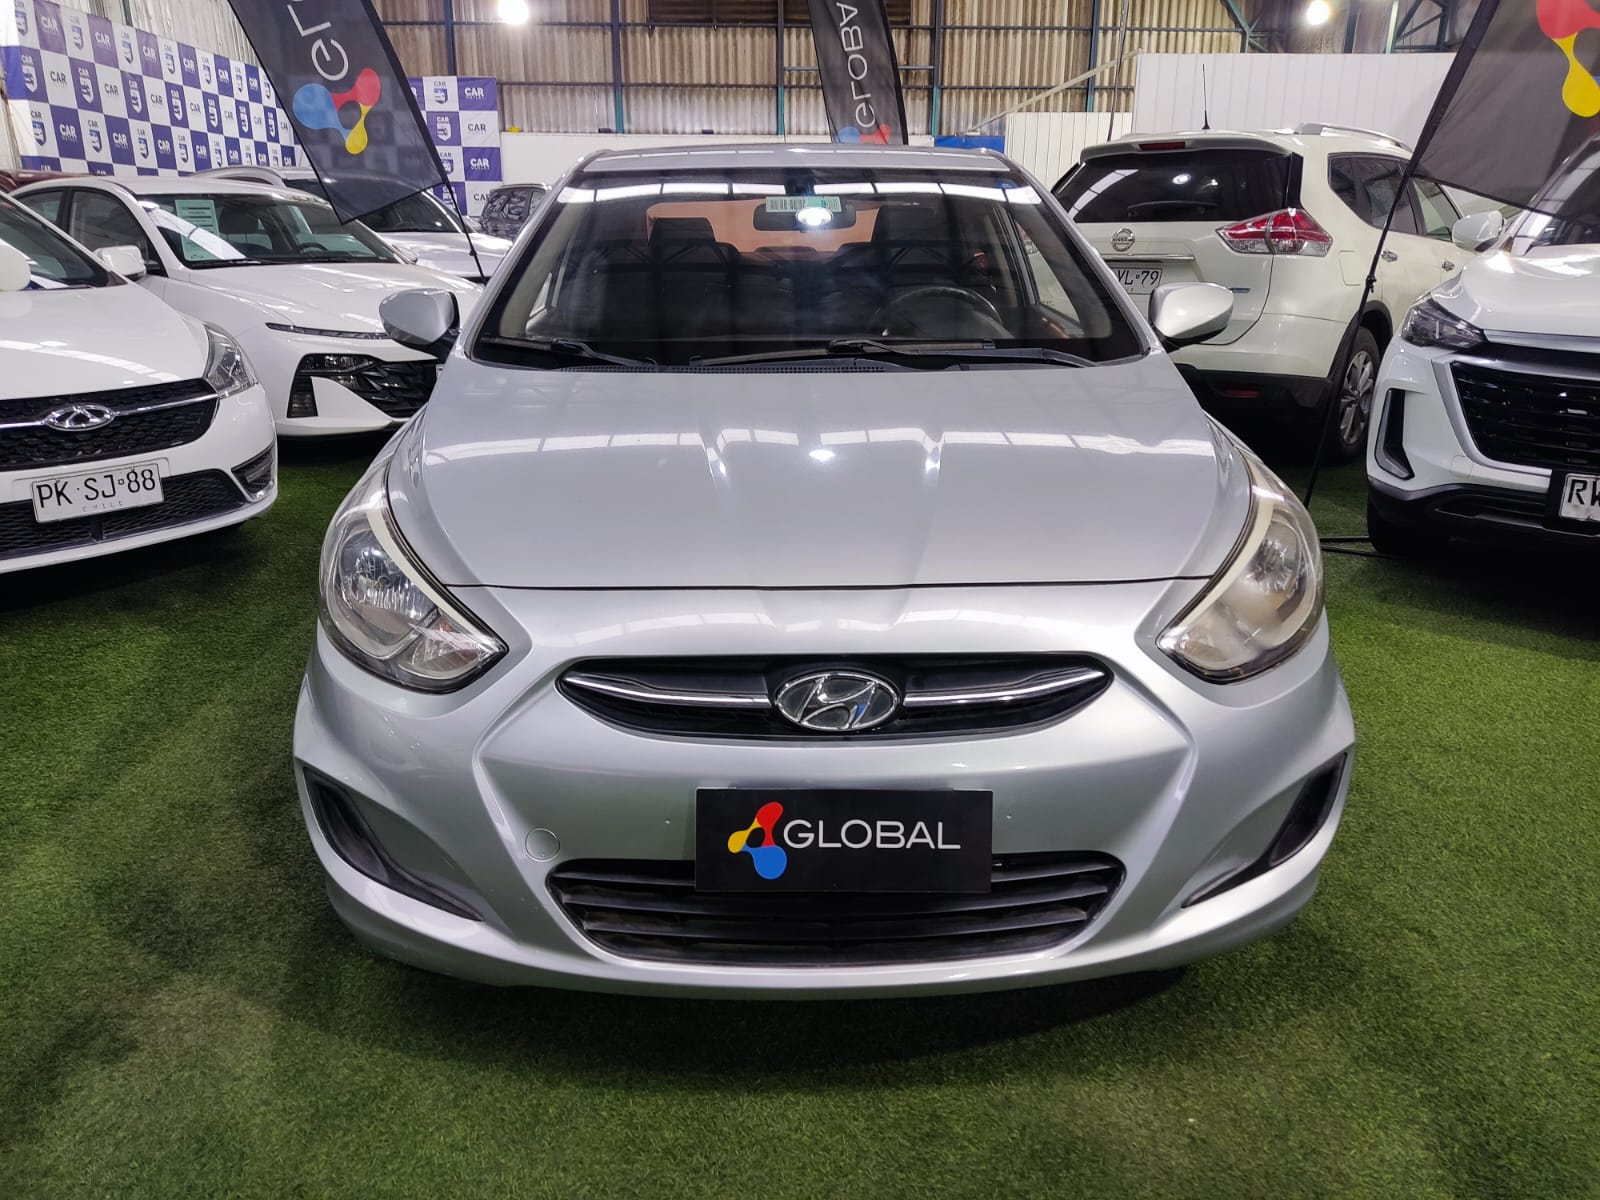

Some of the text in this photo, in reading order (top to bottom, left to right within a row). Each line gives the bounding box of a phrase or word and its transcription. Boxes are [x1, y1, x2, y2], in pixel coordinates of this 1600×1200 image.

[41, 16, 59, 32] CAR
[95, 31, 112, 48] CAR
[287, 0, 349, 81] GL
[50, 70, 67, 85] CAR
[104, 83, 119, 96] CAR
[464, 87, 484, 97] CAR
[150, 94, 163, 105] CAR
[190, 102, 202, 114] CAR
[59, 124, 77, 138] CAR
[467, 123, 487, 132] CAR
[112, 132, 128, 146] CAR
[157, 139, 170, 151] CAR
[470, 158, 490, 167] CAR
[783, 819, 961, 849] GLOBAL
